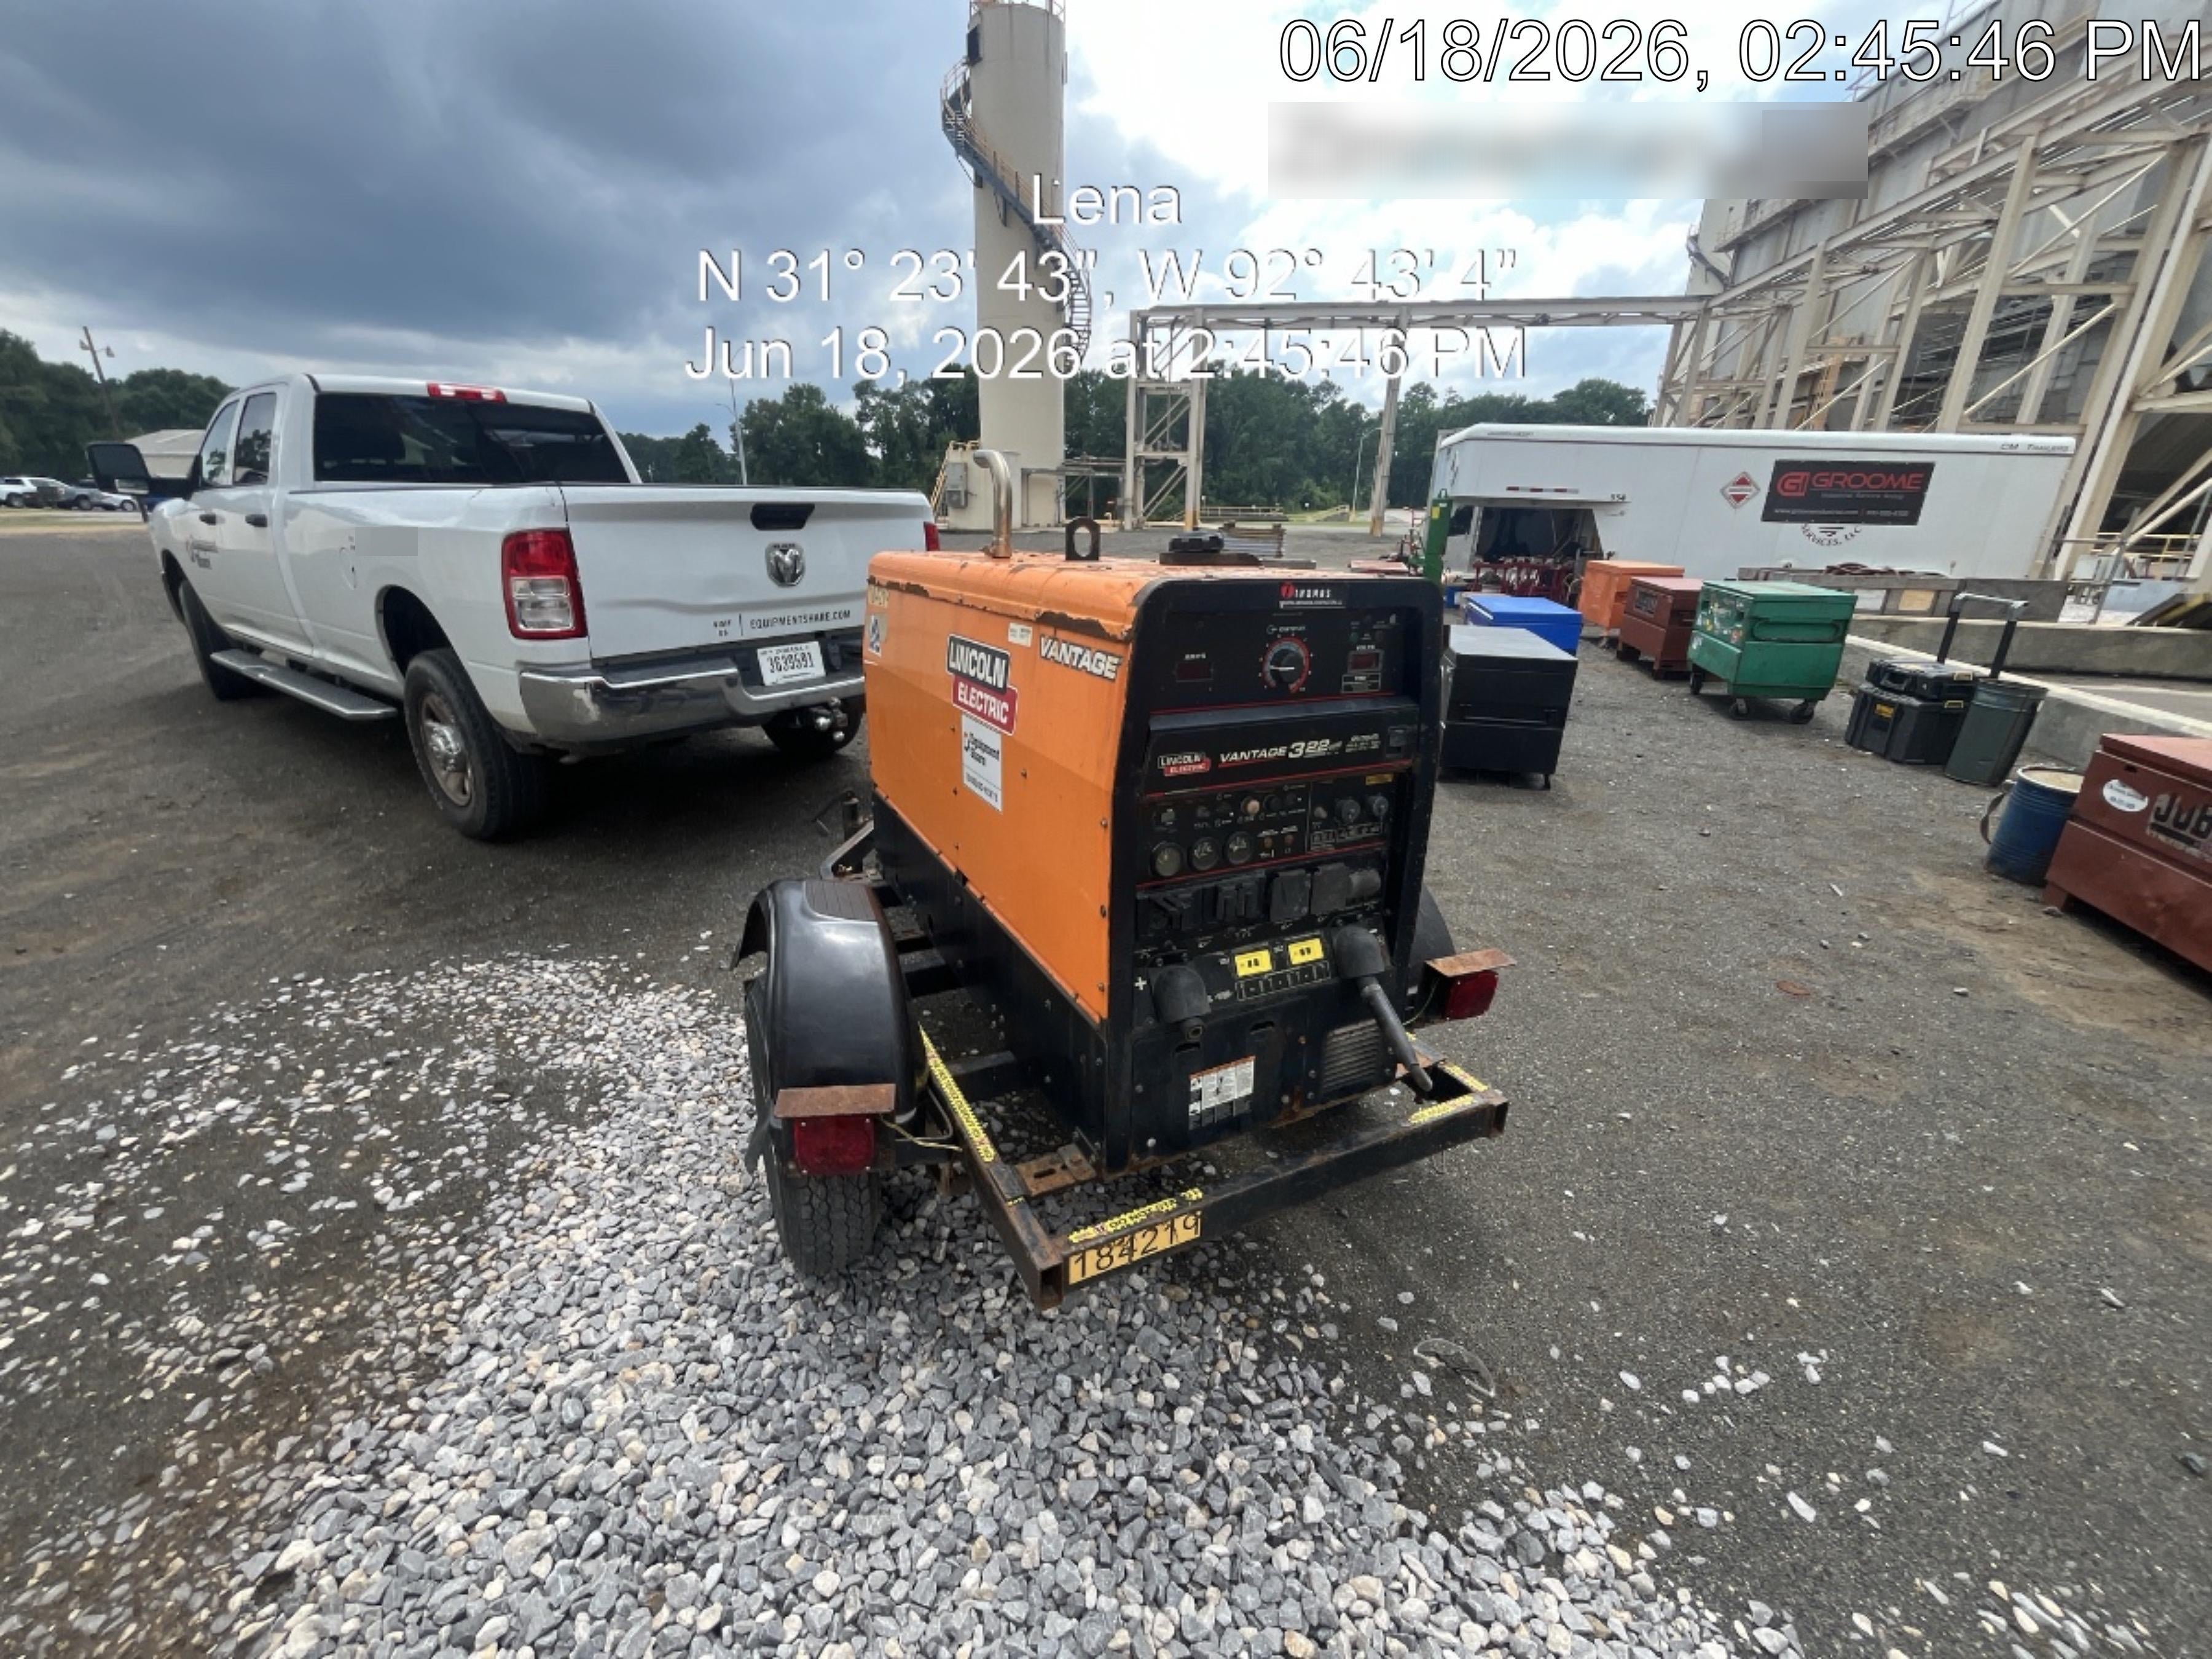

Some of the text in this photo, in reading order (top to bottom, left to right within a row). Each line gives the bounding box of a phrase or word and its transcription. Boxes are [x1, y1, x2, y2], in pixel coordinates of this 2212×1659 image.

[1811, 471, 1926, 490] GROOME
[750, 609, 851, 630] EQUIPMENTSHARE.COM
[949, 640, 1007, 689] LINCOLN
[1040, 636, 1121, 680] VANTAGE
[957, 681, 1010, 724] ELECTRIC
[1161, 753, 1202, 766] LINCOLN
[1220, 745, 1288, 763] VANTAGE
[1073, 1212, 1201, 1278] 184219
